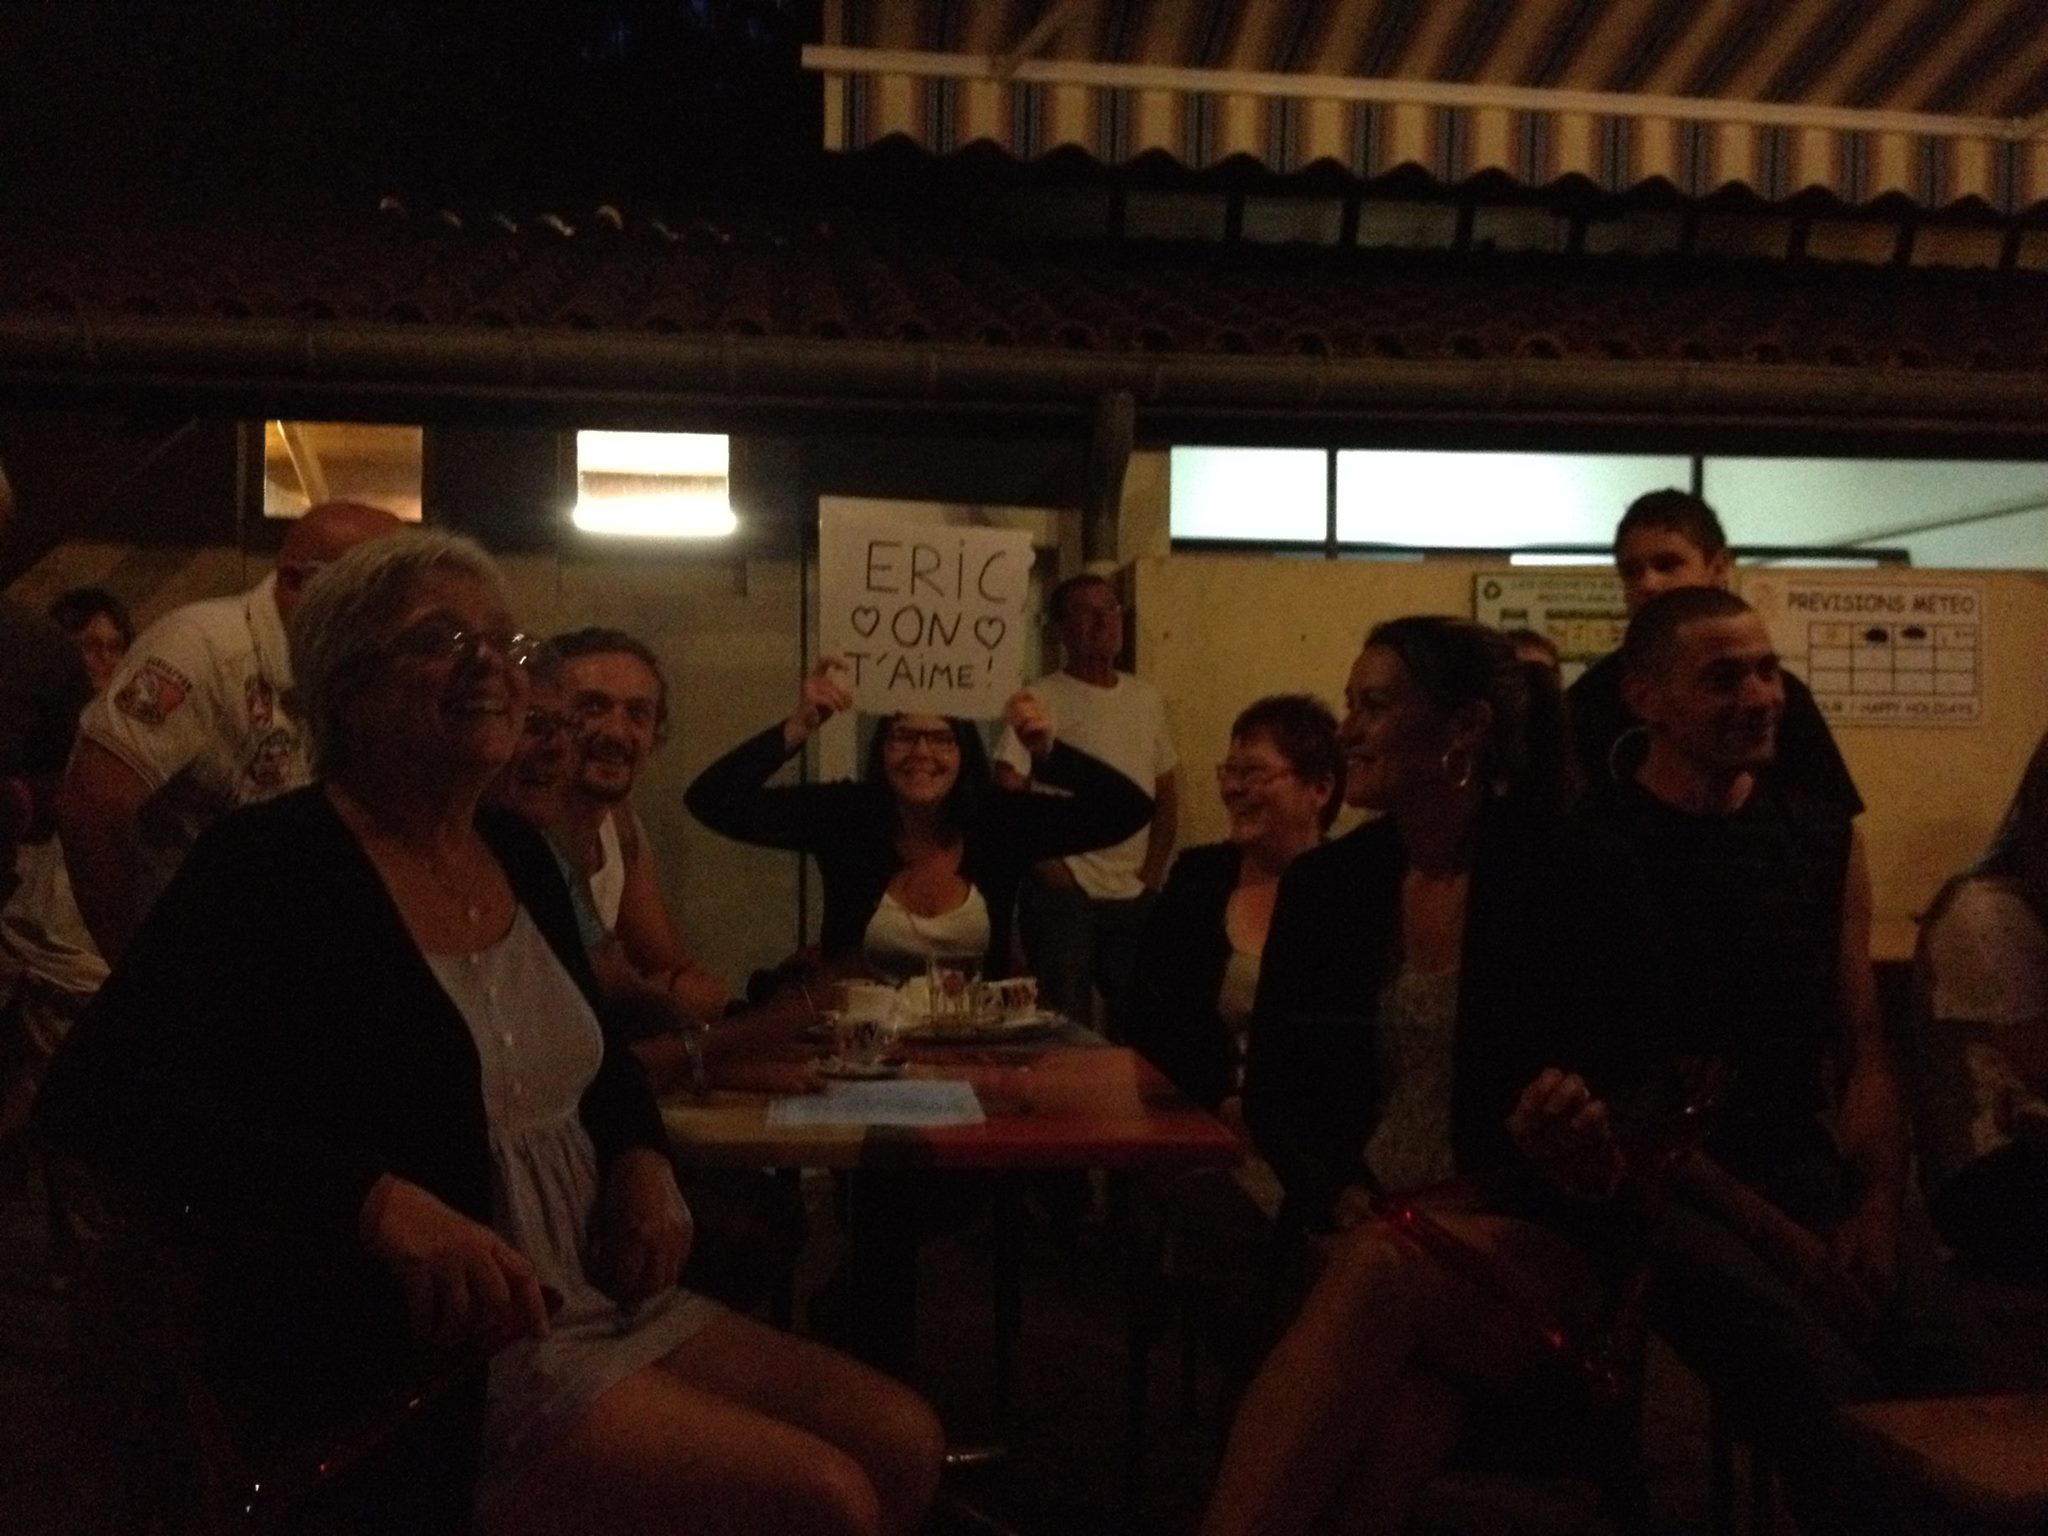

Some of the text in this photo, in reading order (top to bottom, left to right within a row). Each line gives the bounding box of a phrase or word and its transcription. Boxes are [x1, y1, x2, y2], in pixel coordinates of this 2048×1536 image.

[1788, 591, 1976, 614] PREVISIONS METEO
[891, 604, 963, 648] ON
